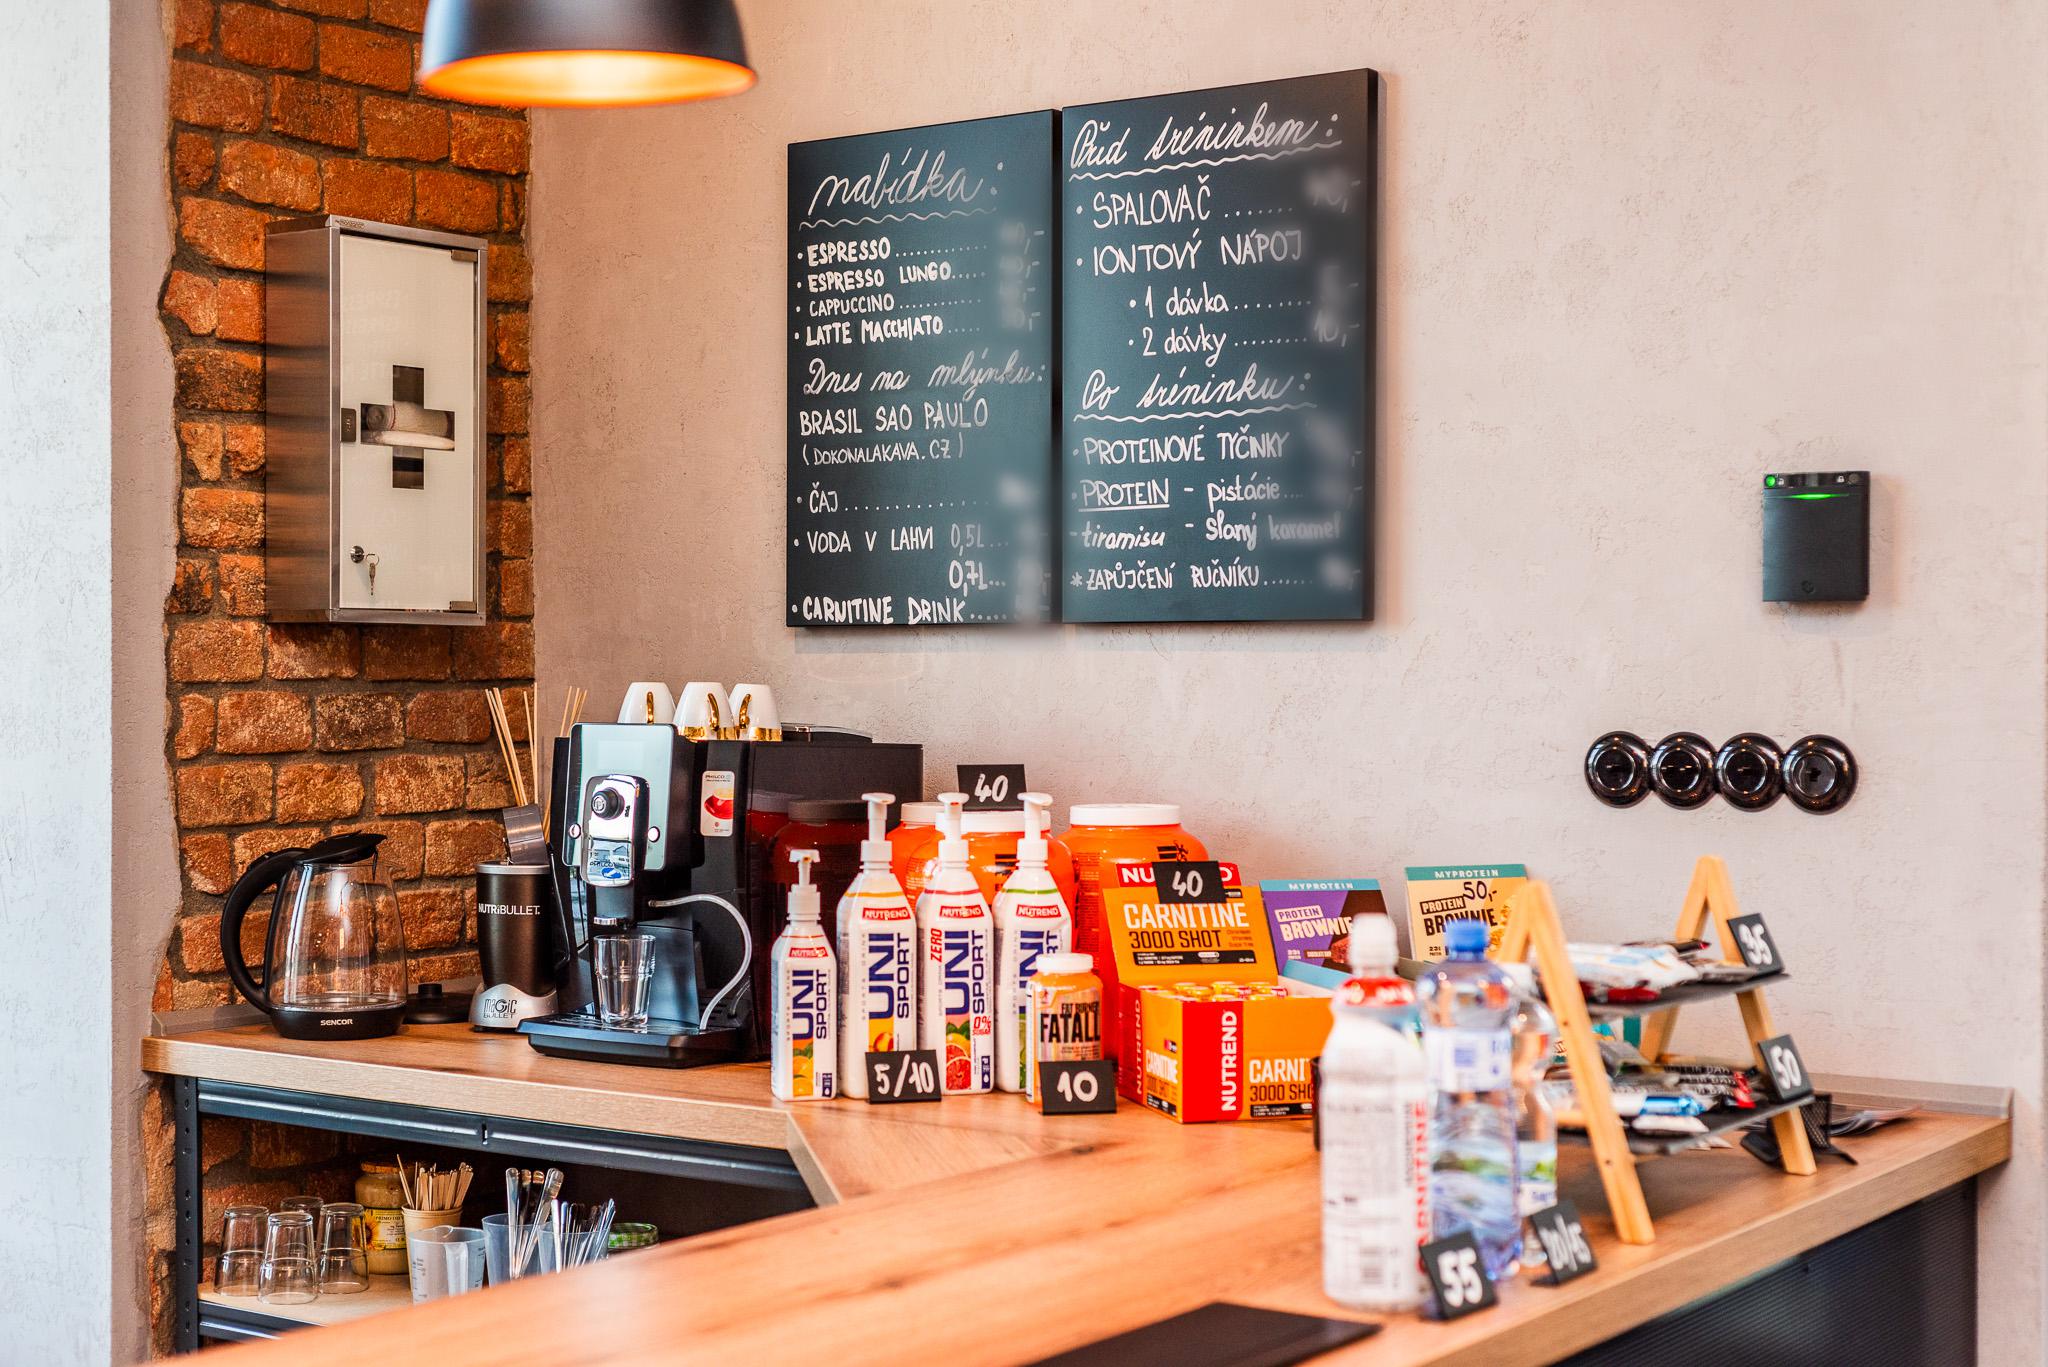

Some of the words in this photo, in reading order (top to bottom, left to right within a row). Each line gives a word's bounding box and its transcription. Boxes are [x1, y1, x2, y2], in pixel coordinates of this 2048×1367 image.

[1093, 174, 1211, 229] SPALOVAČ
[807, 236, 891, 267] ESPRESSO
[1093, 228, 1202, 276] IONTOVÝ
[1220, 228, 1302, 266] NÁPOJ
[807, 268, 885, 293] ESPRESSO
[899, 261, 952, 284] LUNGO
[809, 293, 895, 317] CAPPUCCINO
[1144, 285, 1154, 318] 1
[1165, 282, 1229, 316] dávka
[805, 322, 852, 347] LATTE
[861, 315, 944, 345] MACCHIATO
[1142, 327, 1157, 356] 2
[1164, 323, 1227, 367] dávky
[803, 357, 863, 396] Dnes
[870, 370, 911, 392] na
[1082, 368, 1120, 410] Po
[799, 407, 863, 436] BRASIL
[875, 403, 913, 432] SAO
[924, 398, 989, 430] PAULO
[1083, 424, 1206, 465] PROTEINOVÉ
[1216, 424, 1291, 461] TYČINKY
[808, 481, 839, 514] ČAJ
[1079, 477, 1170, 507] PROTEIN
[1207, 472, 1281, 513] pistácie
[807, 530, 852, 554] VODA
[864, 531, 877, 552] V
[891, 526, 934, 551] LAHVI
[1081, 520, 1166, 550] tiramisu
[1190, 556, 1260, 589] RUČNÍKU
[802, 596, 894, 625] CARNITINE
[907, 595, 966, 625] DRINK
[975, 774, 1009, 802] 40
[1172, 870, 1204, 898] 40
[1288, 882, 1354, 890] MYPROTEIN
[1434, 869, 1499, 879] MYPROTEIN
[864, 909, 908, 920] NUTREND
[1018, 905, 1058, 917] NUTREND
[1123, 902, 1250, 929] CARNITINE
[1278, 908, 1320, 920] PROTEIN
[1421, 896, 1464, 914] PROTEIN
[930, 928, 943, 963] ZERO
[1128, 930, 1175, 949] 3000
[1178, 929, 1222, 948] SHOT
[868, 933, 894, 1020] UNI
[896, 932, 909, 1019] SPORT
[944, 930, 970, 1016] UNI
[971, 929, 986, 1015] SPORT
[792, 969, 814, 1040] UNI
[815, 969, 828, 1040] SPORT
[1040, 1013, 1101, 1043] FATALL
[874, 1054, 935, 1098] 5/10
[1221, 1010, 1237, 1111] NUTREND
[1249, 1057, 1311, 1084] CARNI
[1057, 1070, 1098, 1102] 10
[1250, 1085, 1285, 1102] 3000
